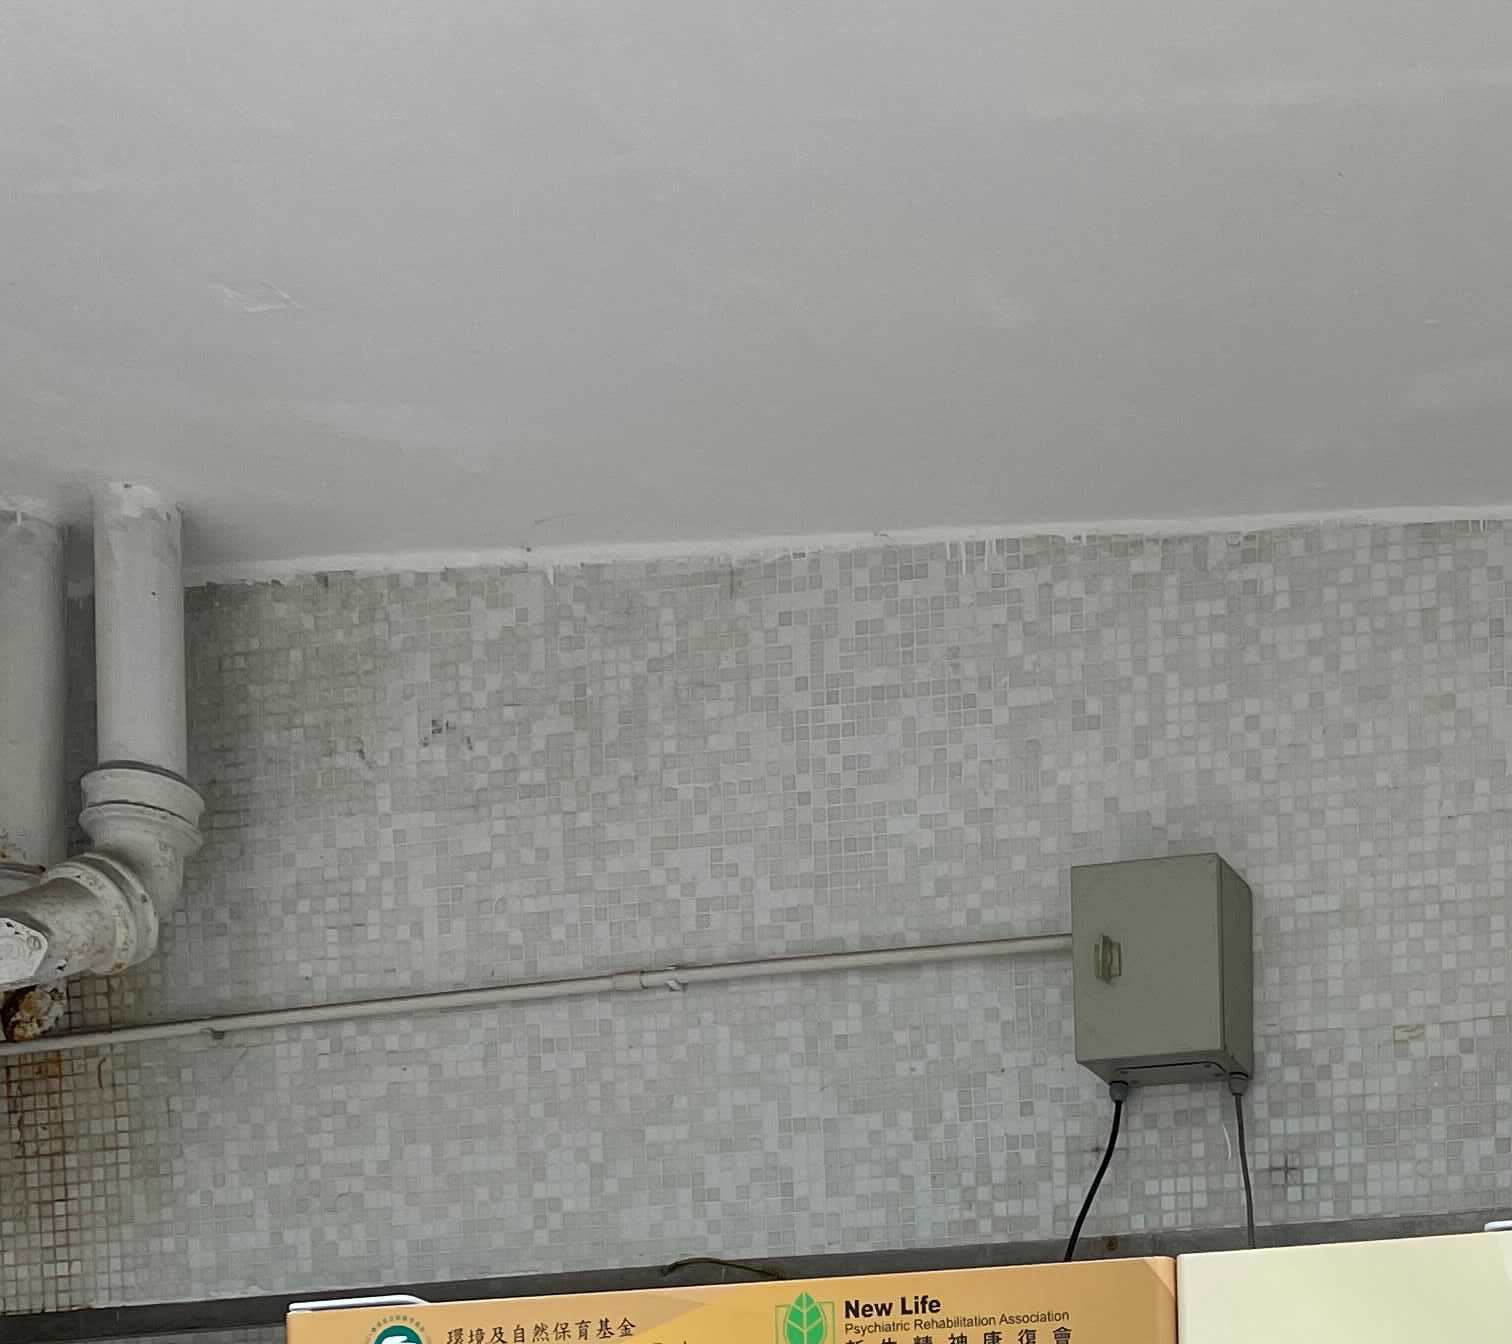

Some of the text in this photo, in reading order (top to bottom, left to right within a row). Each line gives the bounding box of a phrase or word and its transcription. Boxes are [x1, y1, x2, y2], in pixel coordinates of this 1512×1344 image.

[844, 1295, 941, 1320] New Life
[844, 1310, 1070, 1337] Psychiatric Rehabilitation Association
